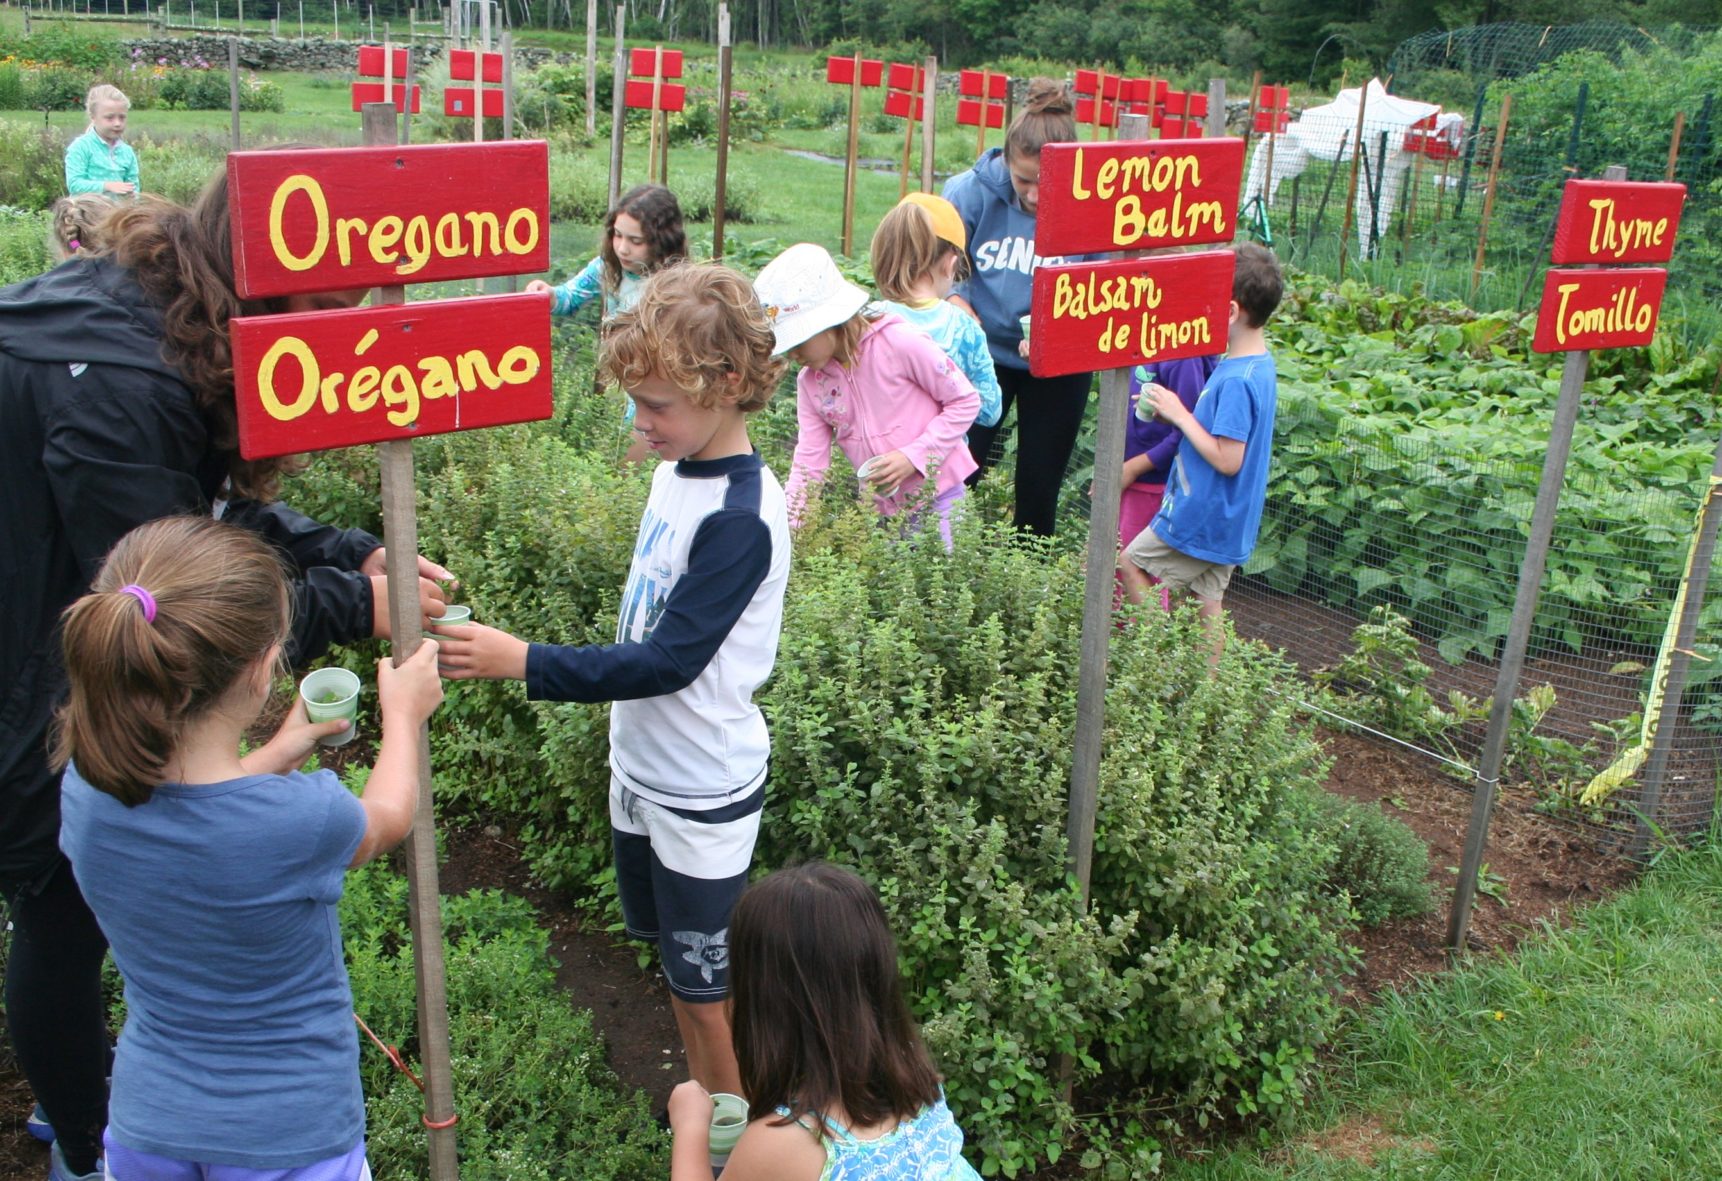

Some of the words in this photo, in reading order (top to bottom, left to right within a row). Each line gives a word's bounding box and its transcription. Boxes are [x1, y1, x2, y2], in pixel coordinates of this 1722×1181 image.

[1072, 148, 1202, 200] Lemon
[269, 174, 540, 275] Oregano
[1112, 192, 1226, 246] Balm
[1588, 198, 1668, 258] Thyme
[1053, 272, 1162, 320] Balsam
[1556, 284, 1652, 345] Tomillo
[1098, 317, 1131, 353] de
[258, 329, 540, 427] Orégano
